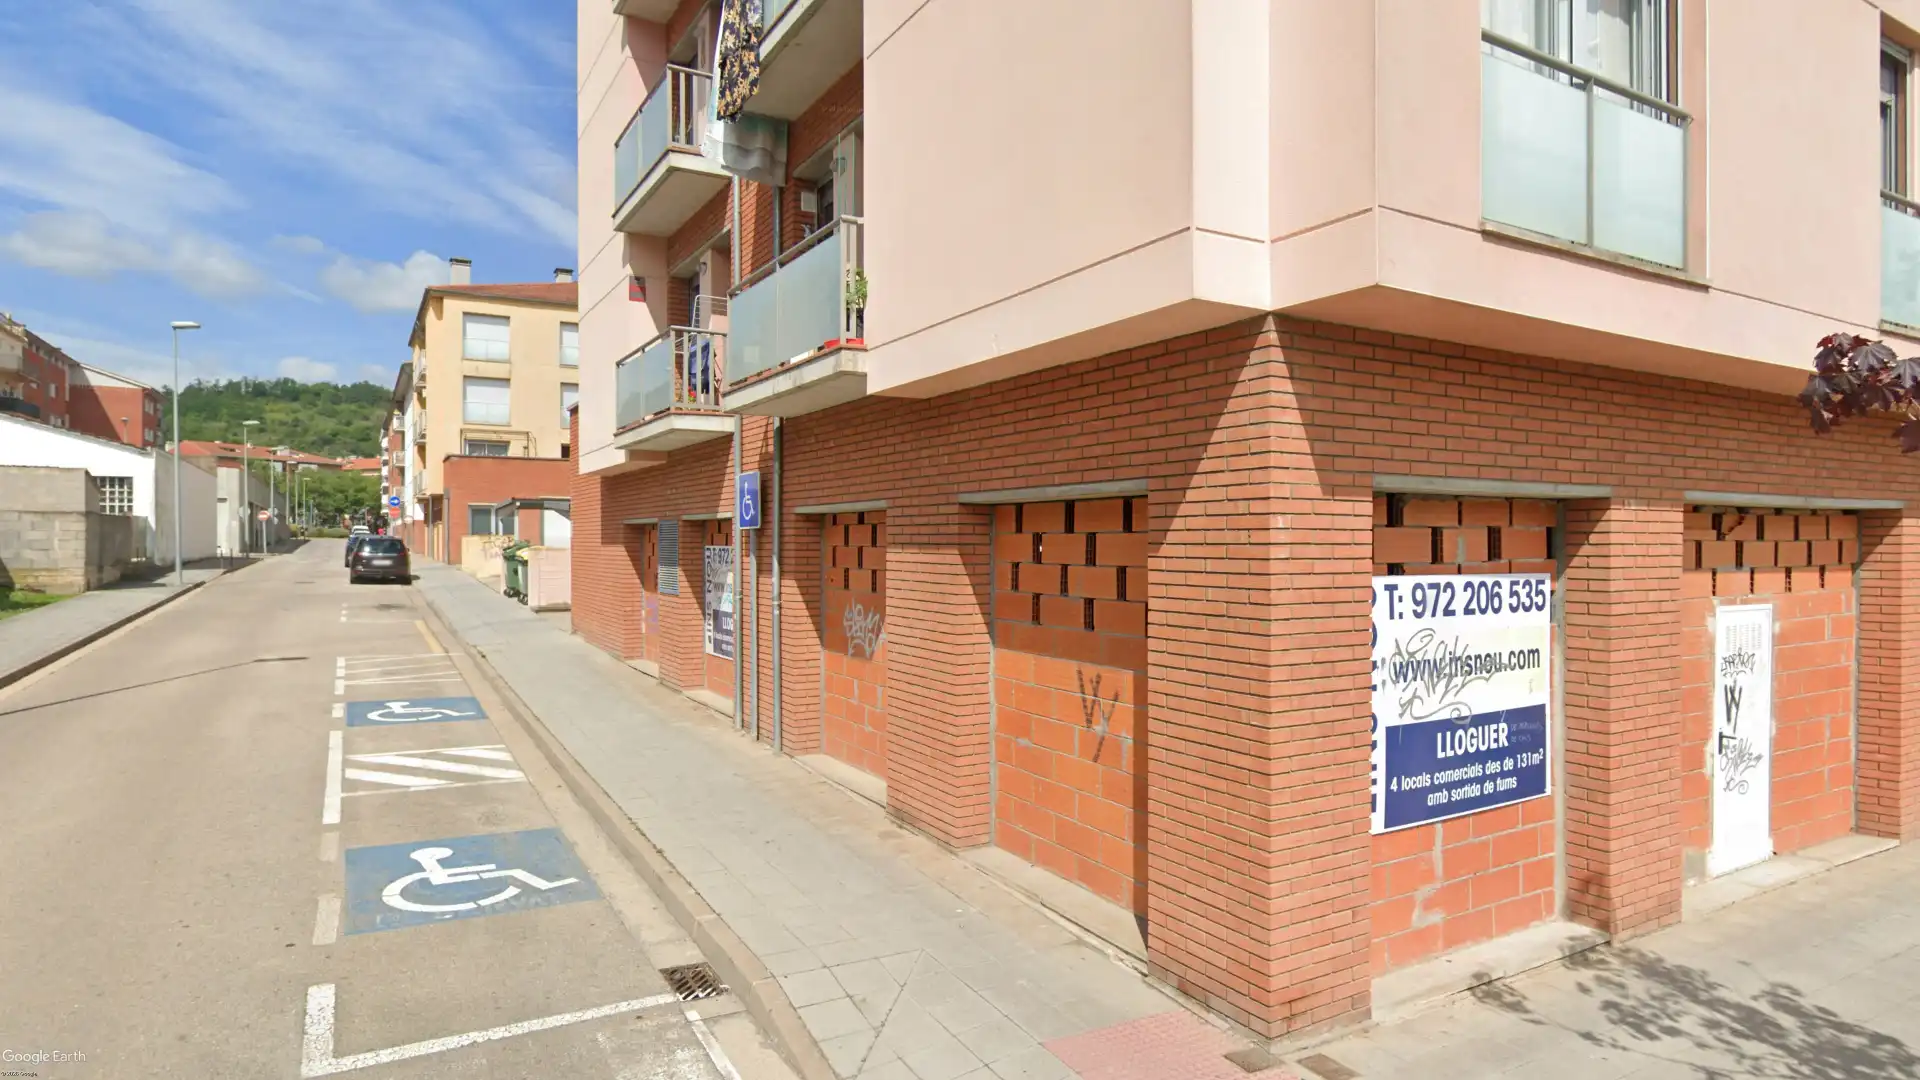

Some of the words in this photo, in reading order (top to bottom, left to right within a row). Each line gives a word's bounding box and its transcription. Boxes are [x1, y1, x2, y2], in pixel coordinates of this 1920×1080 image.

[1384, 583, 1403, 620] T:
[1411, 581, 1456, 619] 972
[1463, 580, 1503, 616] 206
[1508, 579, 1546, 613] 535
[1393, 647, 1540, 684] www.insnou.com
[1436, 722, 1509, 759] LLOGUER
[1390, 776, 1398, 792] 4
[1401, 772, 1431, 791] locals
[1433, 763, 1483, 785] comercials
[1485, 759, 1501, 775] des
[1503, 756, 1514, 771] de
[1427, 787, 1449, 807] amb
[1450, 782, 1481, 801] sortida
[1483, 779, 1494, 794] de
[1496, 775, 1517, 792] fums
